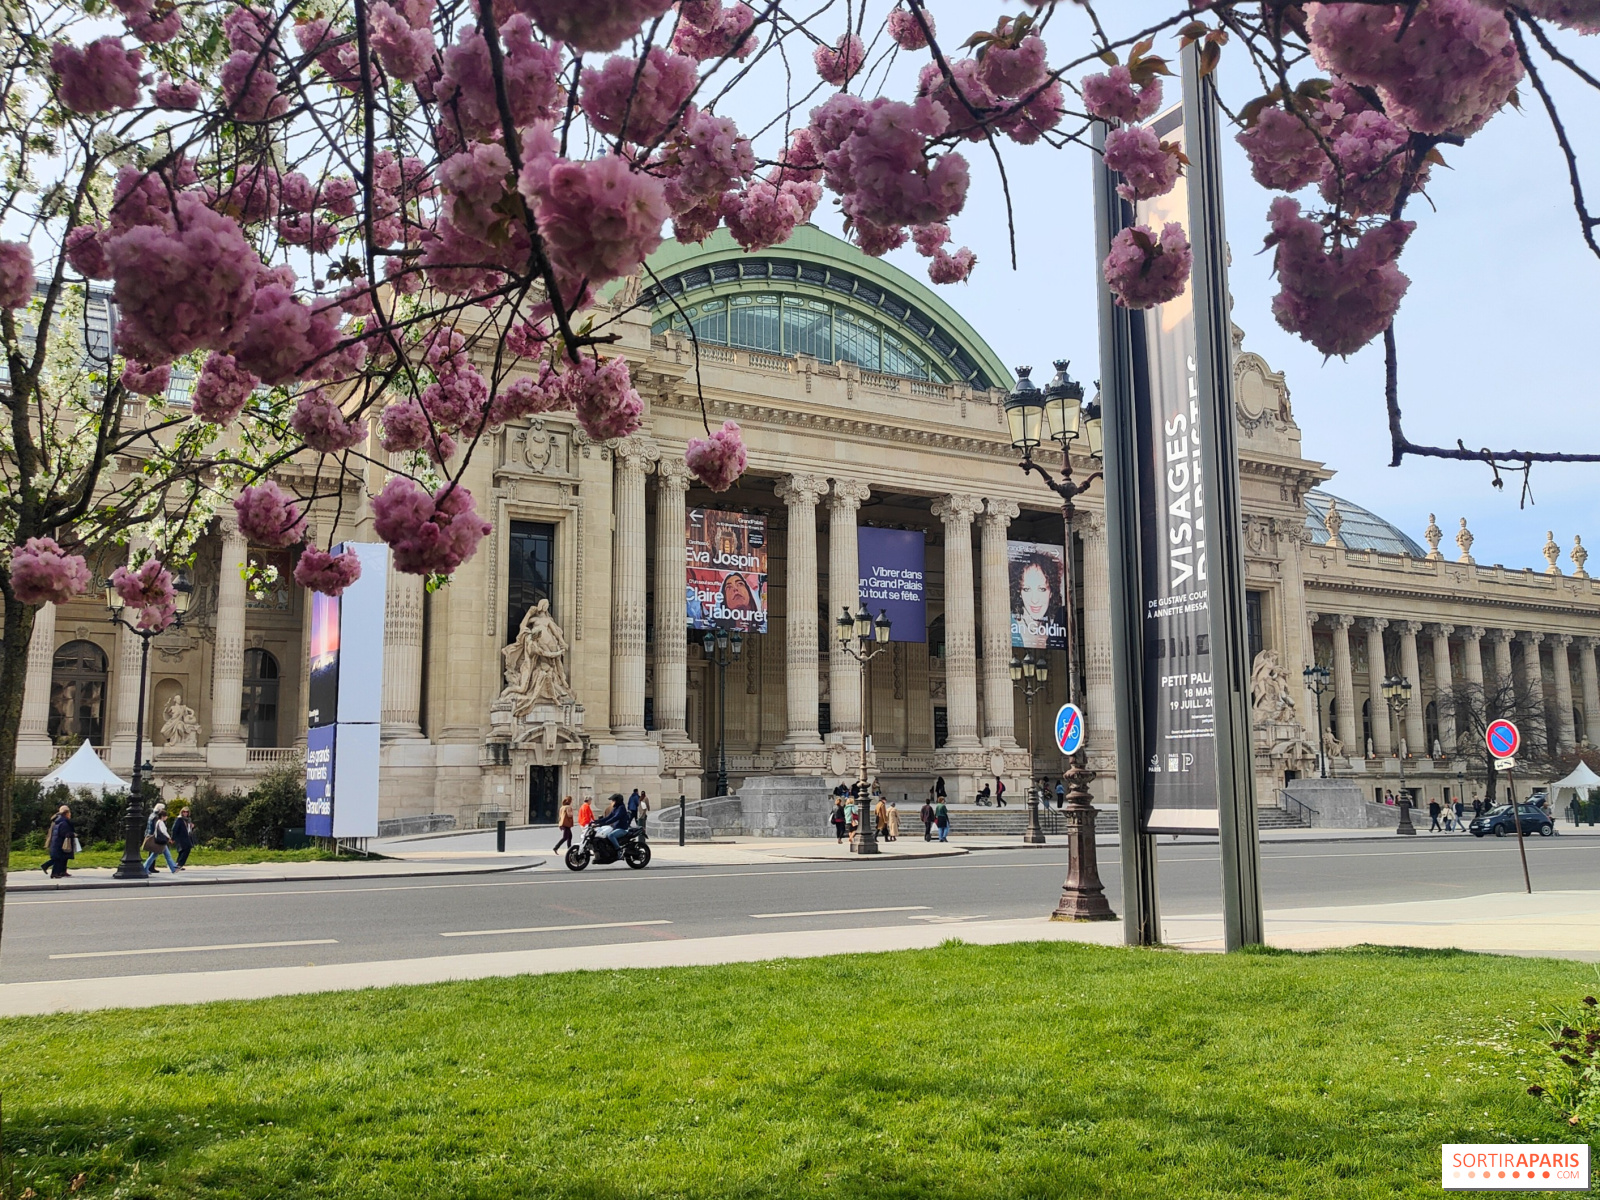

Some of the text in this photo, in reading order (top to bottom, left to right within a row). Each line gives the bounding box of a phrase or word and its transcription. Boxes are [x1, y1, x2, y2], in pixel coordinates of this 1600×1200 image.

[1165, 414, 1193, 589] VISAGES
[686, 546, 760, 569] Eva Jospin
[872, 566, 923, 580] Vibrer dans
[869, 577, 897, 589] Grand
[898, 579, 923, 591] Palais
[686, 585, 724, 603] Claire
[870, 588, 888, 599] tout
[889, 592, 900, 600] se
[901, 590, 921, 602] fête.
[1148, 599, 1158, 609] DE
[1158, 594, 1187, 606] GUSTAVE
[706, 603, 768, 622] Tabouret
[1147, 609, 1152, 619] À
[1153, 605, 1184, 618] ANNETTE
[1028, 621, 1067, 637] Goldin
[1161, 674, 1188, 688] PETIT
[1184, 688, 1194, 698] 18
[1170, 701, 1179, 710] 19
[1180, 699, 1204, 710] JUILL.
[315, 745, 330, 767] grands
[306, 764, 327, 780] moments
